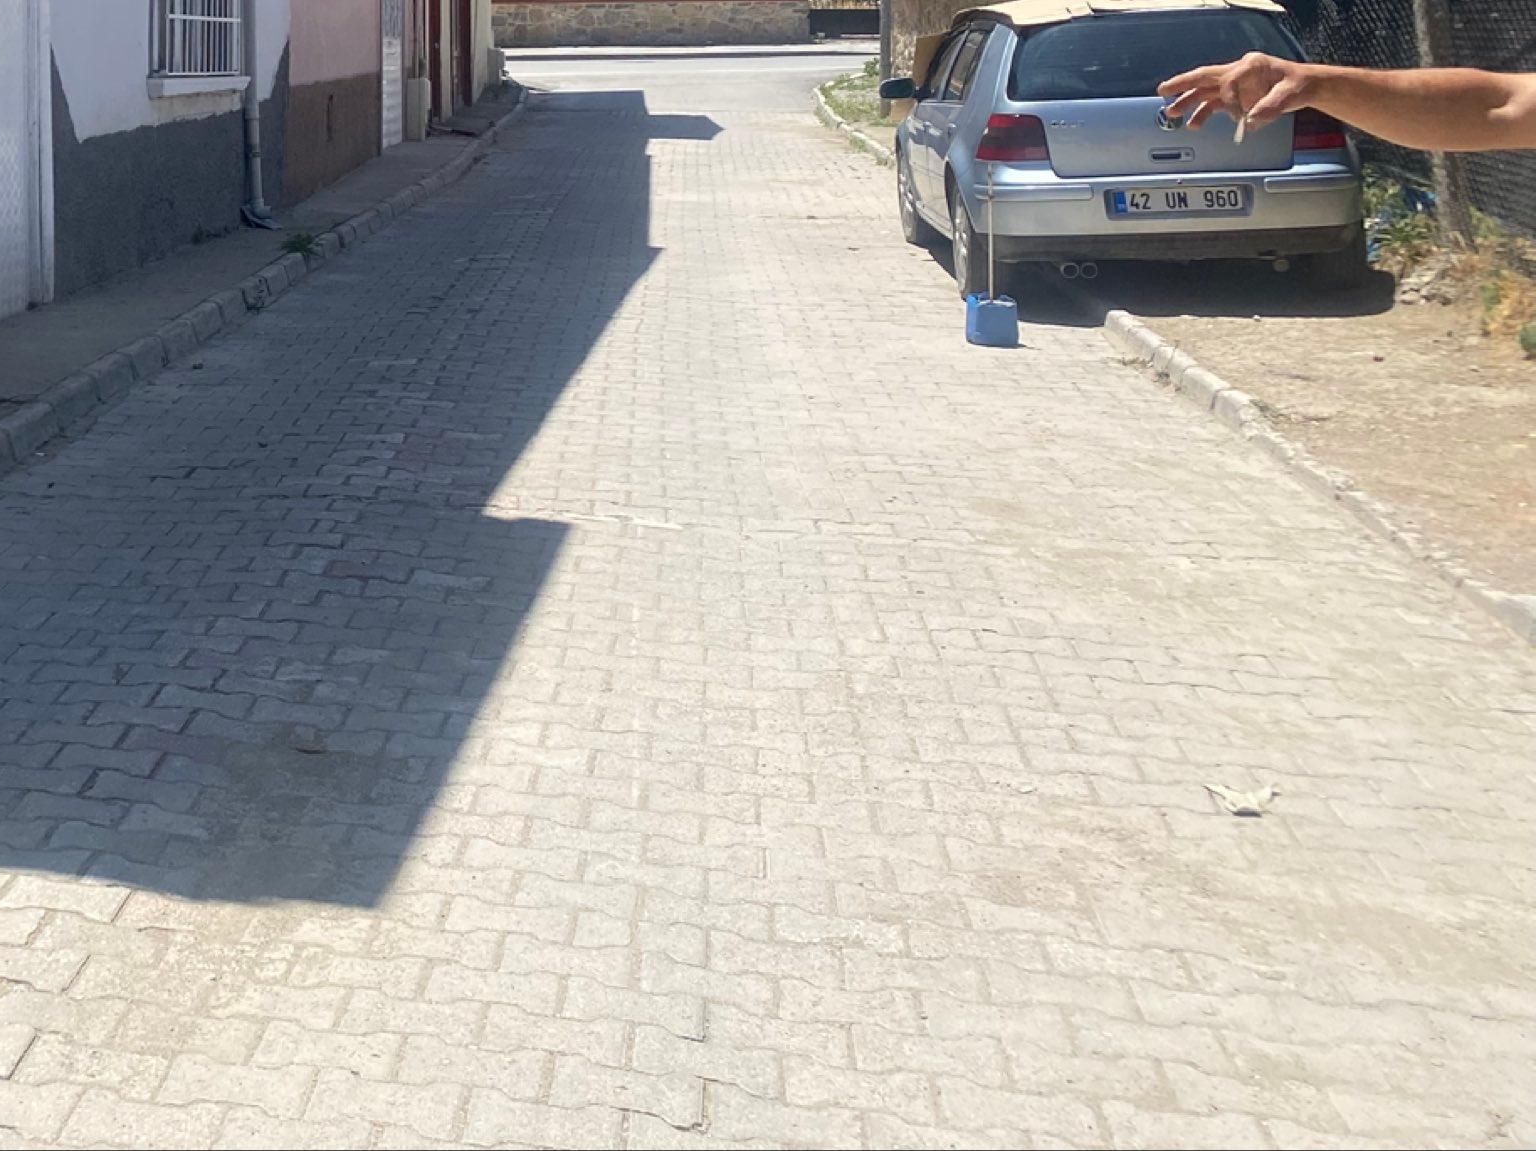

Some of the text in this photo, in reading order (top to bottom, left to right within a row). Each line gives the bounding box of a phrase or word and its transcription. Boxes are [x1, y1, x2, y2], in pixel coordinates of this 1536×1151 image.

[1130, 190, 1238, 210] 42 UN 960
